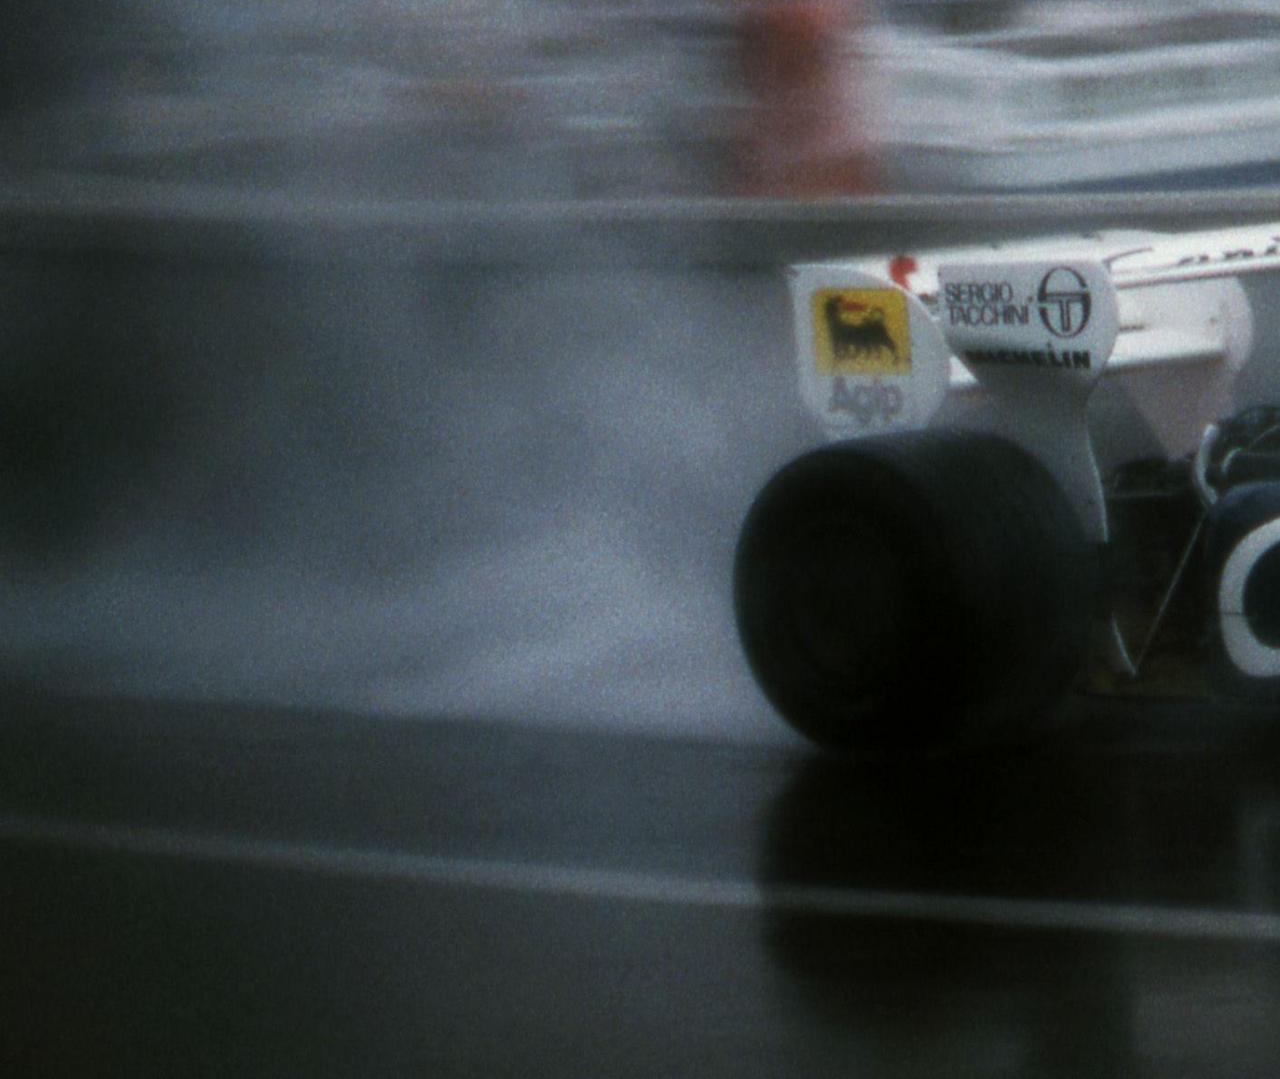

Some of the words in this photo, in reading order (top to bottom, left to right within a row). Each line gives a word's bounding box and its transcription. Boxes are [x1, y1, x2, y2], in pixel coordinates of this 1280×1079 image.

[945, 281, 1013, 304] SERGIO
[950, 303, 1029, 325] TACCHINI
[828, 375, 904, 424] Agip
